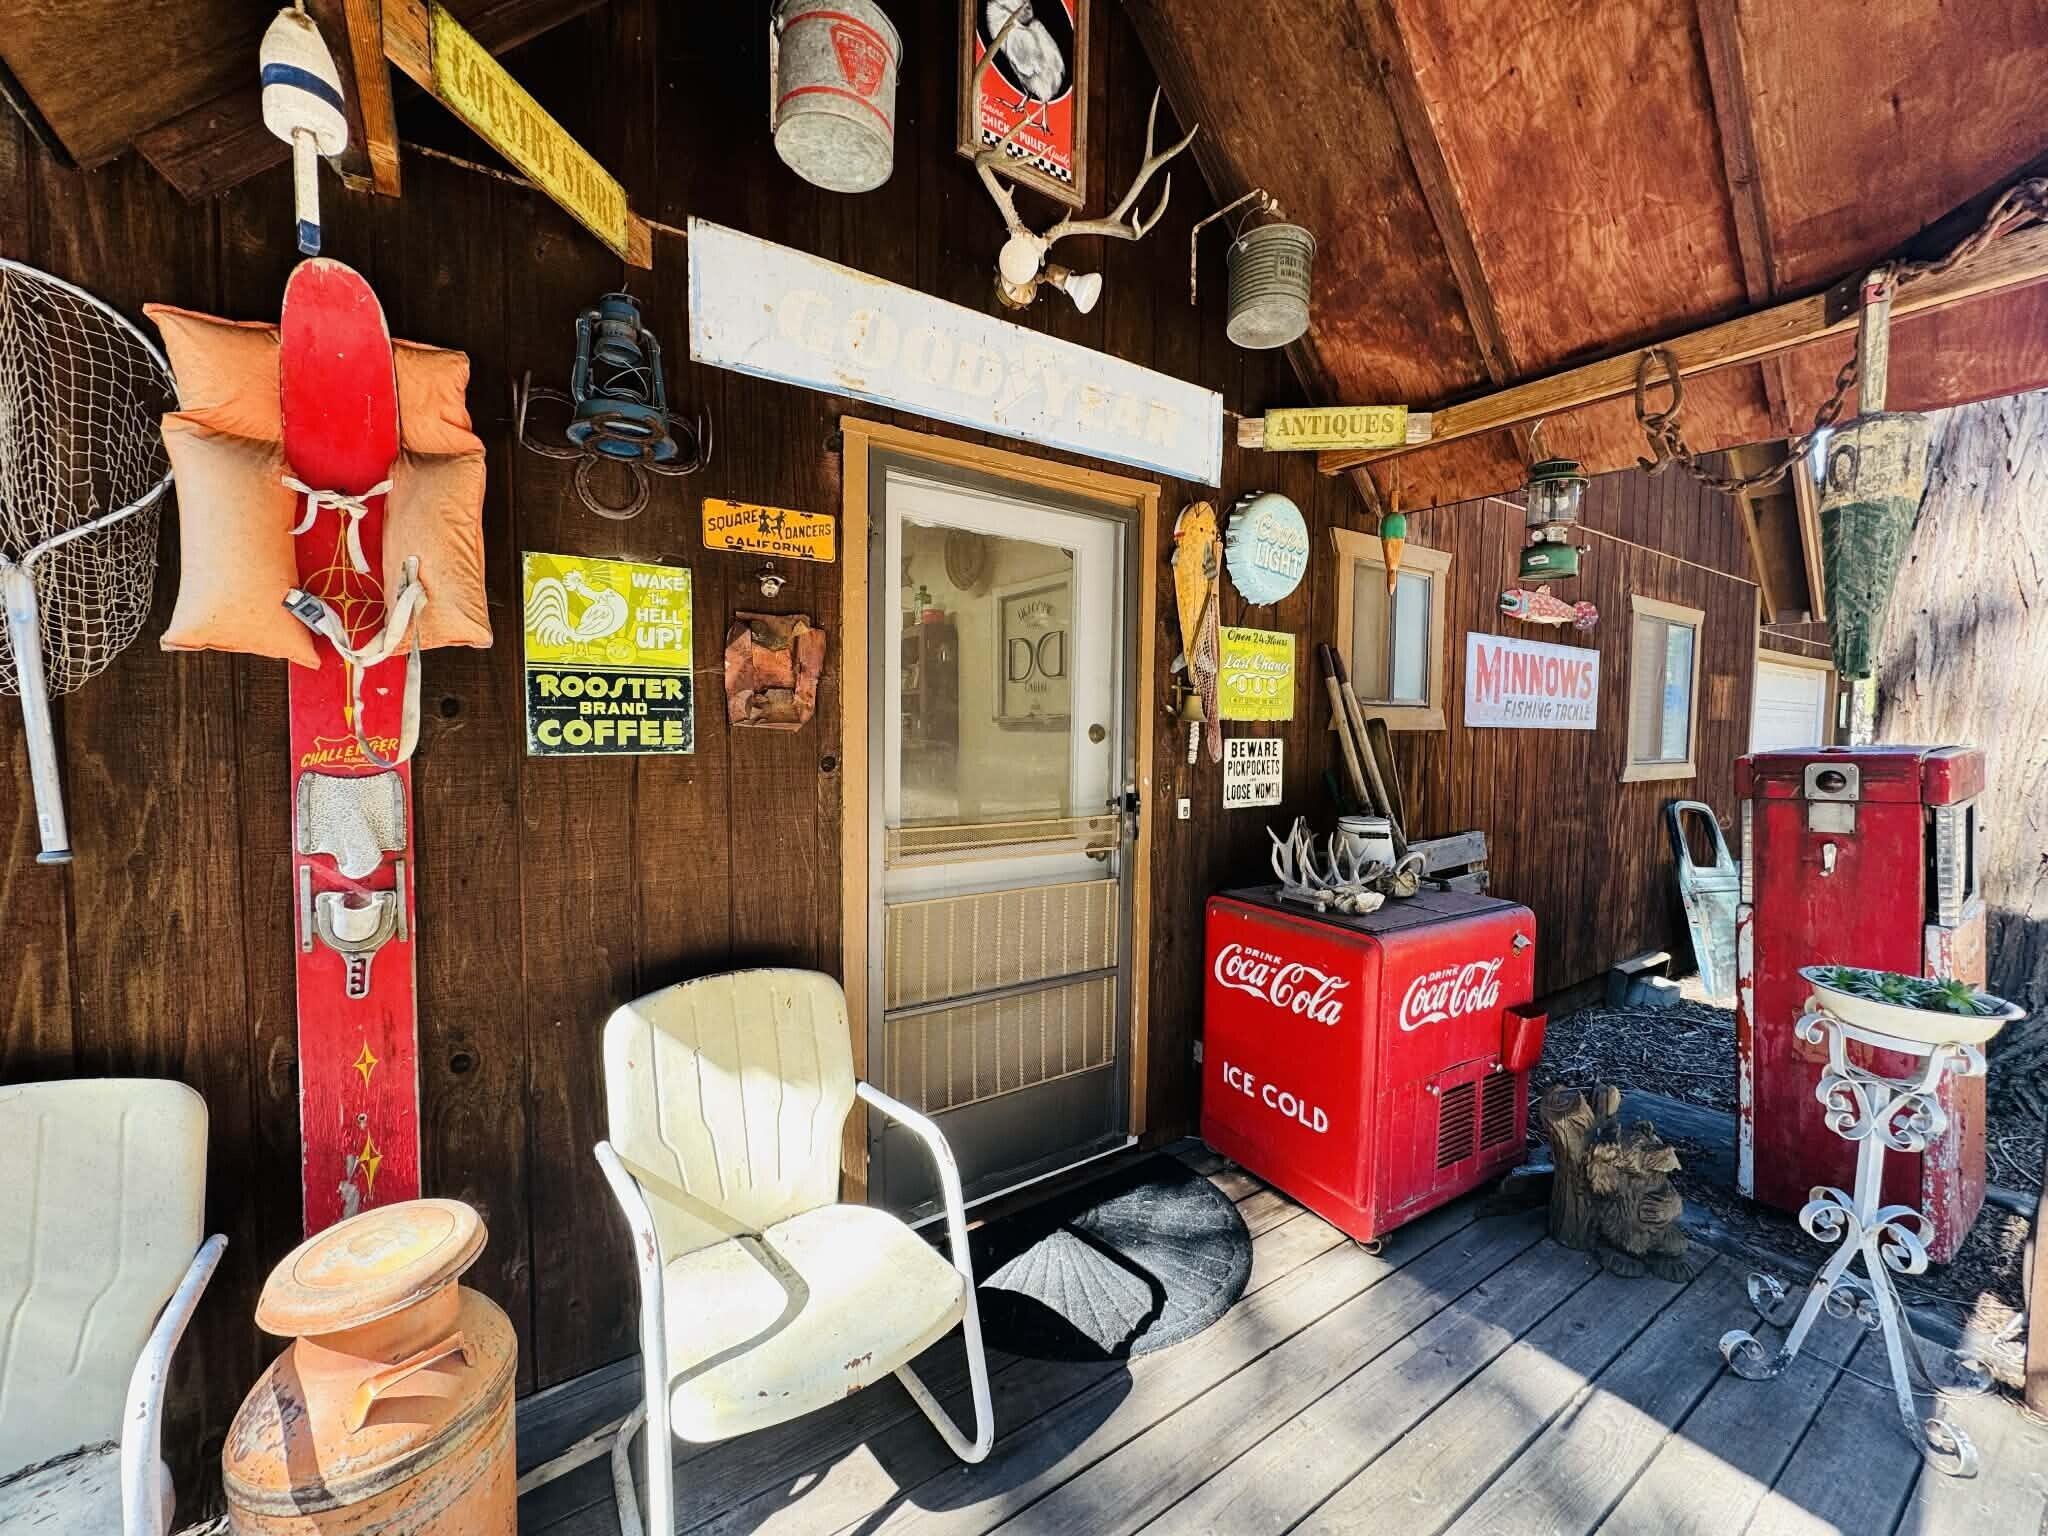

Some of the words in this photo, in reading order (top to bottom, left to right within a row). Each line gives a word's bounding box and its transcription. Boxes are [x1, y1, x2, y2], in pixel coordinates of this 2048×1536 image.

[981, 111, 1010, 133] CHICK
[1276, 412, 1394, 439] ANTIQUES
[707, 509, 758, 533] SQUARE
[785, 523, 832, 540] DANCERS
[724, 535, 815, 554] CALIFORNIA
[631, 572, 686, 592] WAKE
[635, 607, 683, 625] HELL
[636, 626, 683, 650] UP!
[1227, 630, 1251, 643] Open
[1253, 632, 1264, 645] 24
[1264, 634, 1288, 646] Hours
[1223, 653, 1249, 669] Last
[1475, 643, 1593, 704] MINNOWS
[535, 673, 685, 700] ROOSTER
[579, 701, 648, 716] BRAND
[1504, 700, 1552, 720] FISHING
[1555, 703, 1592, 721] TACKLE
[537, 719, 685, 746] COFFEE
[1231, 741, 1278, 758] BEWARE
[1227, 759, 1280, 776] PICKPOCKETS
[1226, 783, 1251, 800] LOOSE
[1255, 782, 1280, 799] WOMEN
[1245, 946, 1283, 966] DRINK
[1214, 943, 1350, 1026] Coca-Cola
[1427, 967, 1460, 983] DRINK
[1399, 956, 1504, 1033] Coca-Cola
[1223, 1061, 1256, 1098] ICE
[1262, 1083, 1329, 1134] COLD
